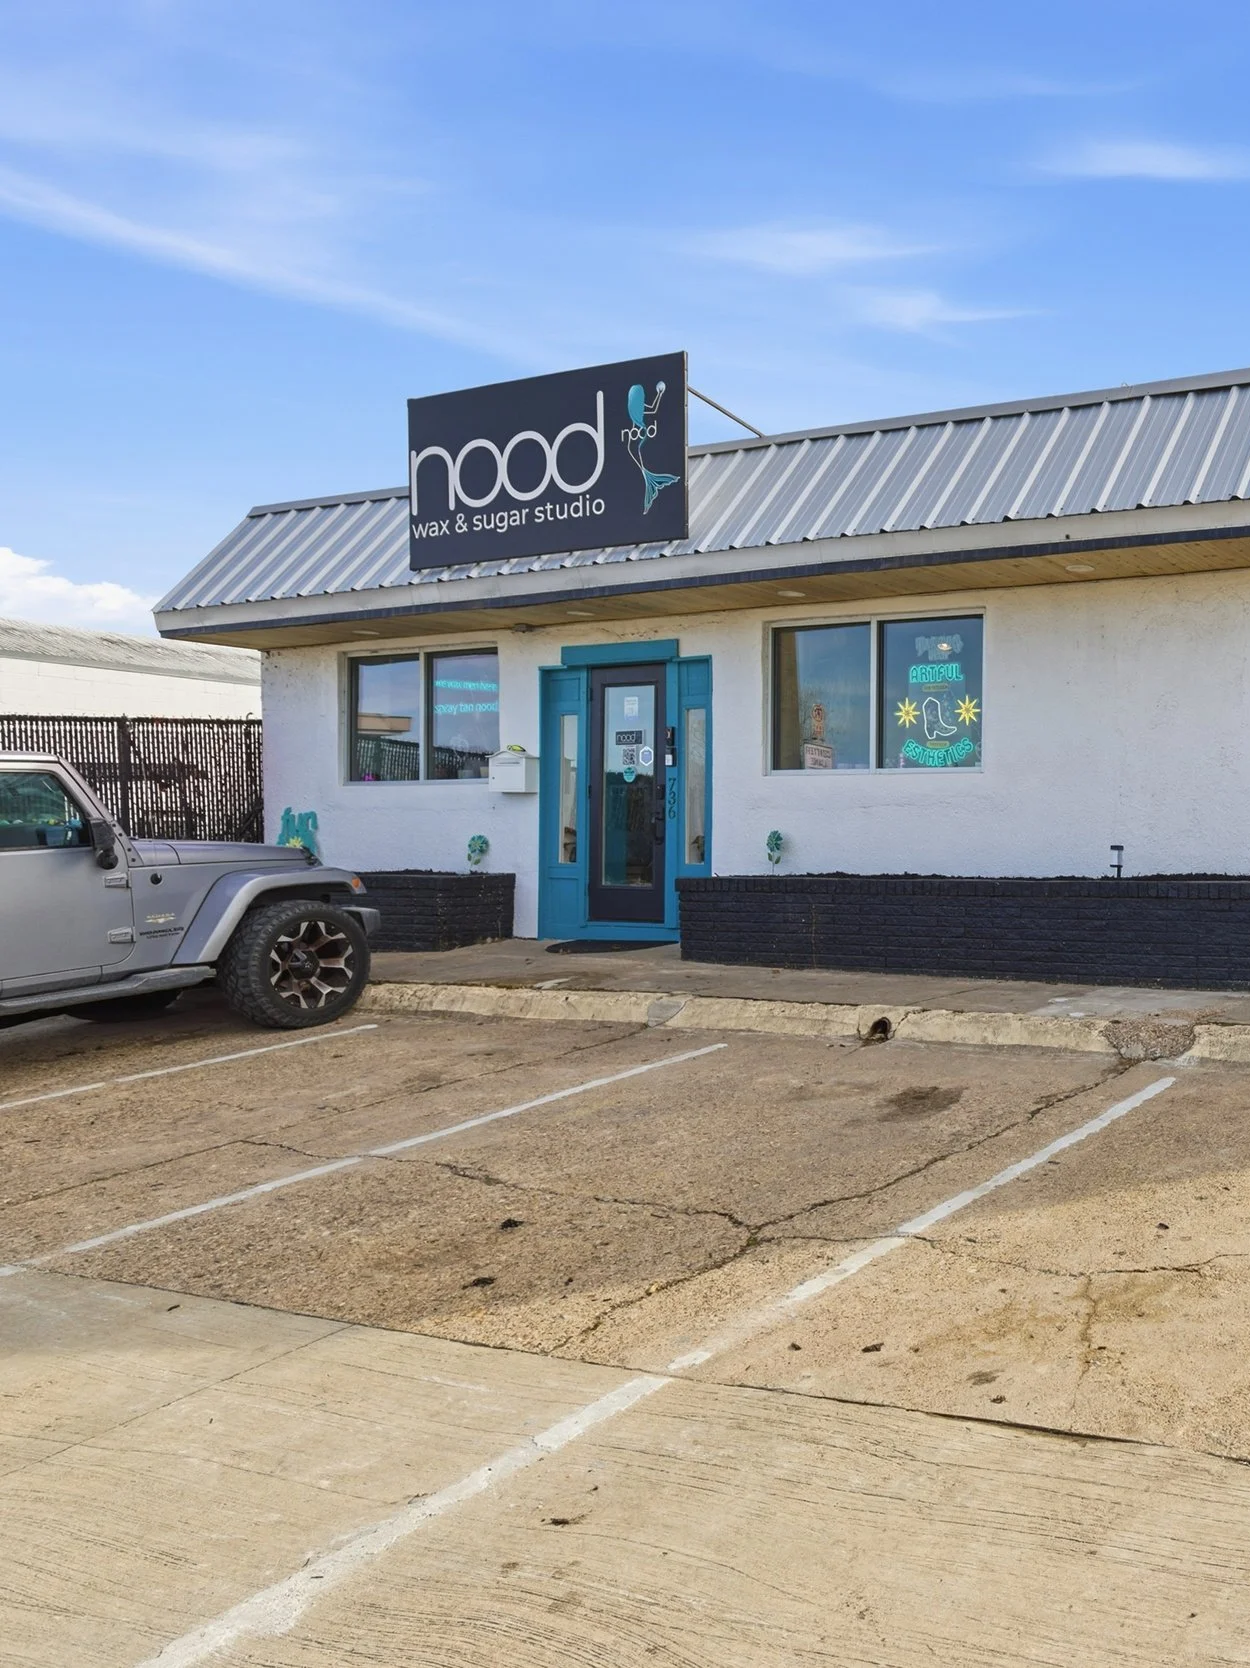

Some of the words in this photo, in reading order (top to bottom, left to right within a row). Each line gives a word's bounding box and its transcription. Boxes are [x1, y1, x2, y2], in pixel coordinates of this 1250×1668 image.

[621, 420, 657, 442] nood
[410, 390, 605, 516] nood
[412, 519, 450, 539] wax
[455, 513, 468, 533] &
[473, 508, 529, 533] sugar
[534, 494, 605, 523] studio
[909, 664, 964, 684] ARTFUL
[434, 703, 458, 715] spray
[459, 702, 474, 712] tan
[902, 737, 974, 766] ESTHETICS
[668, 778, 677, 819] 736
